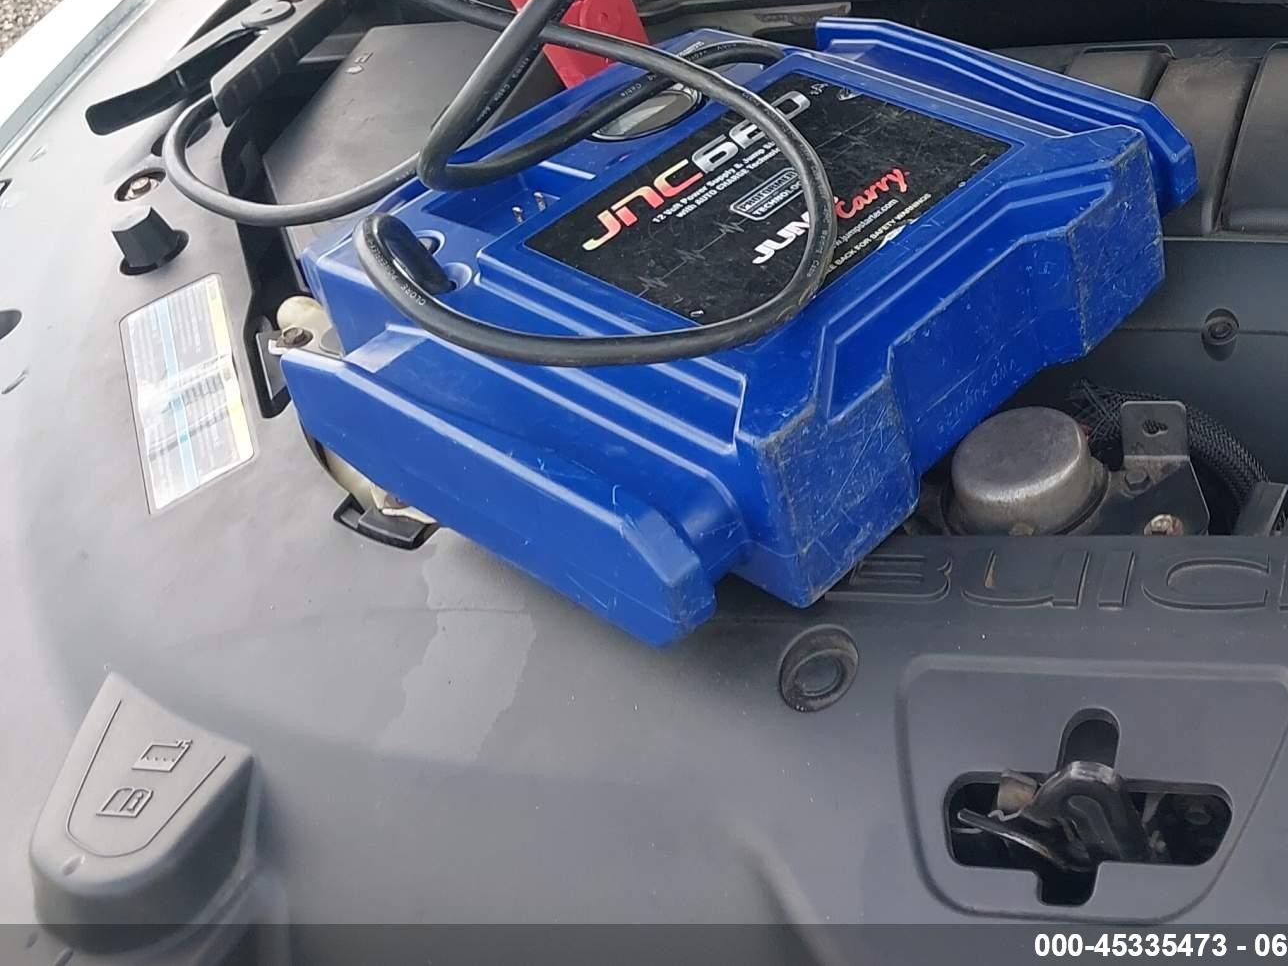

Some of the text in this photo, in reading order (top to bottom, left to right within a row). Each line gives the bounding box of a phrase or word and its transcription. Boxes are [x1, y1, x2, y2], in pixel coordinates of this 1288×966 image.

[651, 146, 764, 224] 12 Volt Power Supply & Jump
[675, 201, 698, 218] with
[694, 188, 717, 206] AUTO
[715, 167, 749, 191] CHARGE
[752, 209, 810, 265] JUM
[833, 168, 908, 217] Carry
[834, 192, 932, 265] BACK FOR SAFETY WARNINGS
